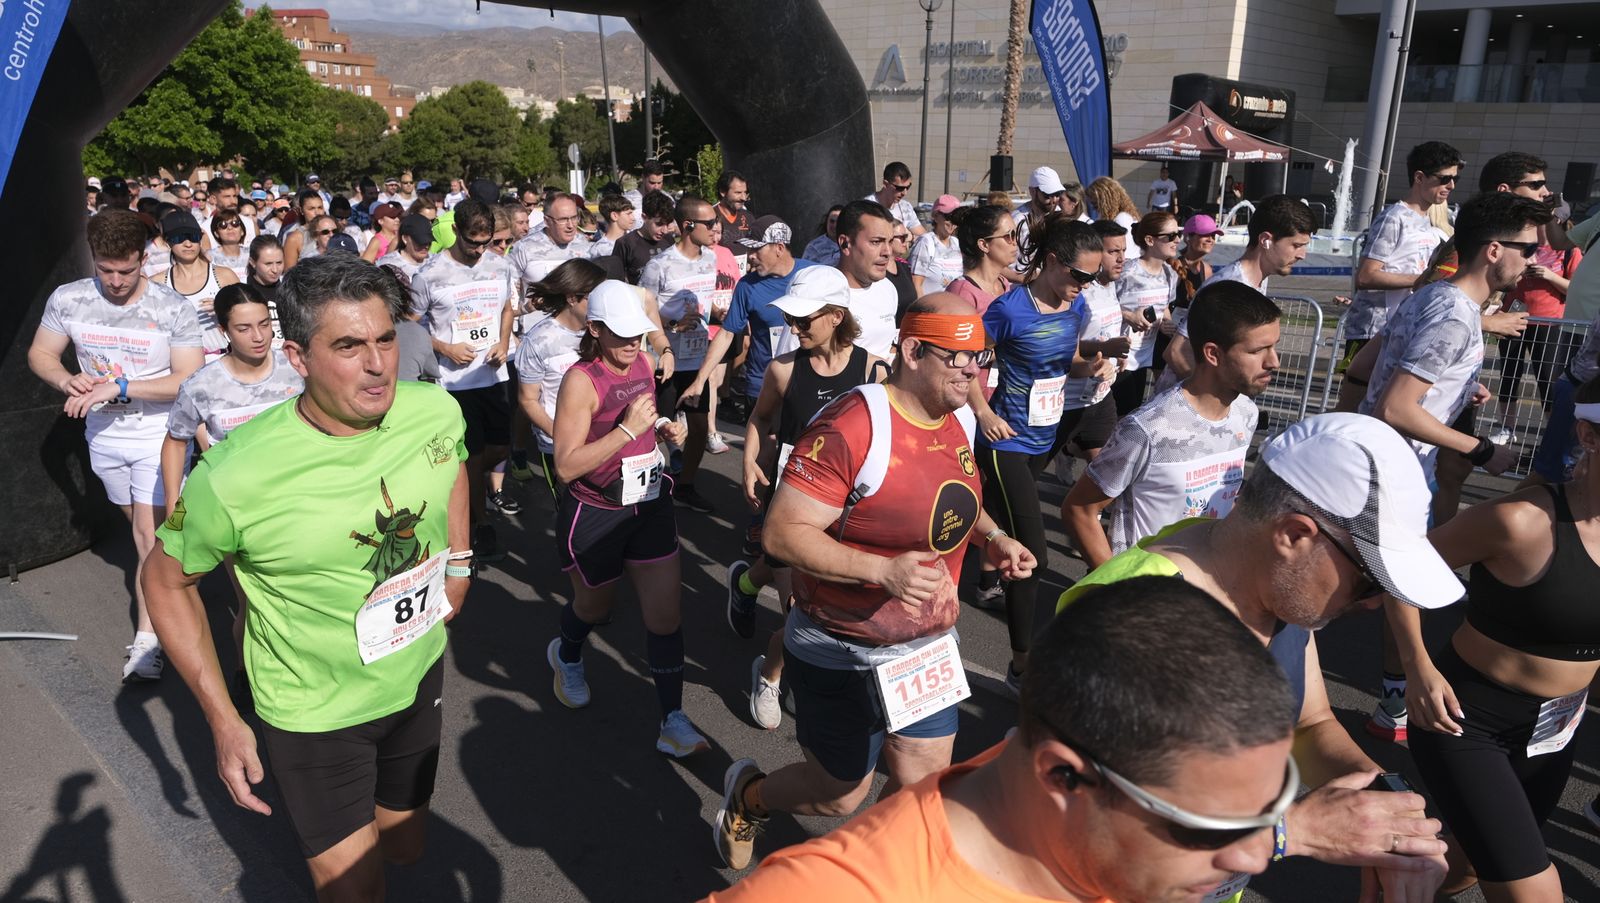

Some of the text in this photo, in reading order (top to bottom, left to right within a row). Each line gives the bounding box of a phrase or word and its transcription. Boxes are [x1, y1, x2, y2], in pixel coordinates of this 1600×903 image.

[470, 327, 488, 340] 86
[1193, 464, 1219, 480] CARRERA
[942, 514, 958, 527] entre
[943, 509, 954, 518] uno
[412, 571, 425, 584] SIN
[394, 584, 430, 624] 87
[891, 655, 921, 672] CARRERA
[920, 650, 932, 660] SIN
[932, 642, 949, 655] HUMO
[894, 660, 955, 703] 1155
